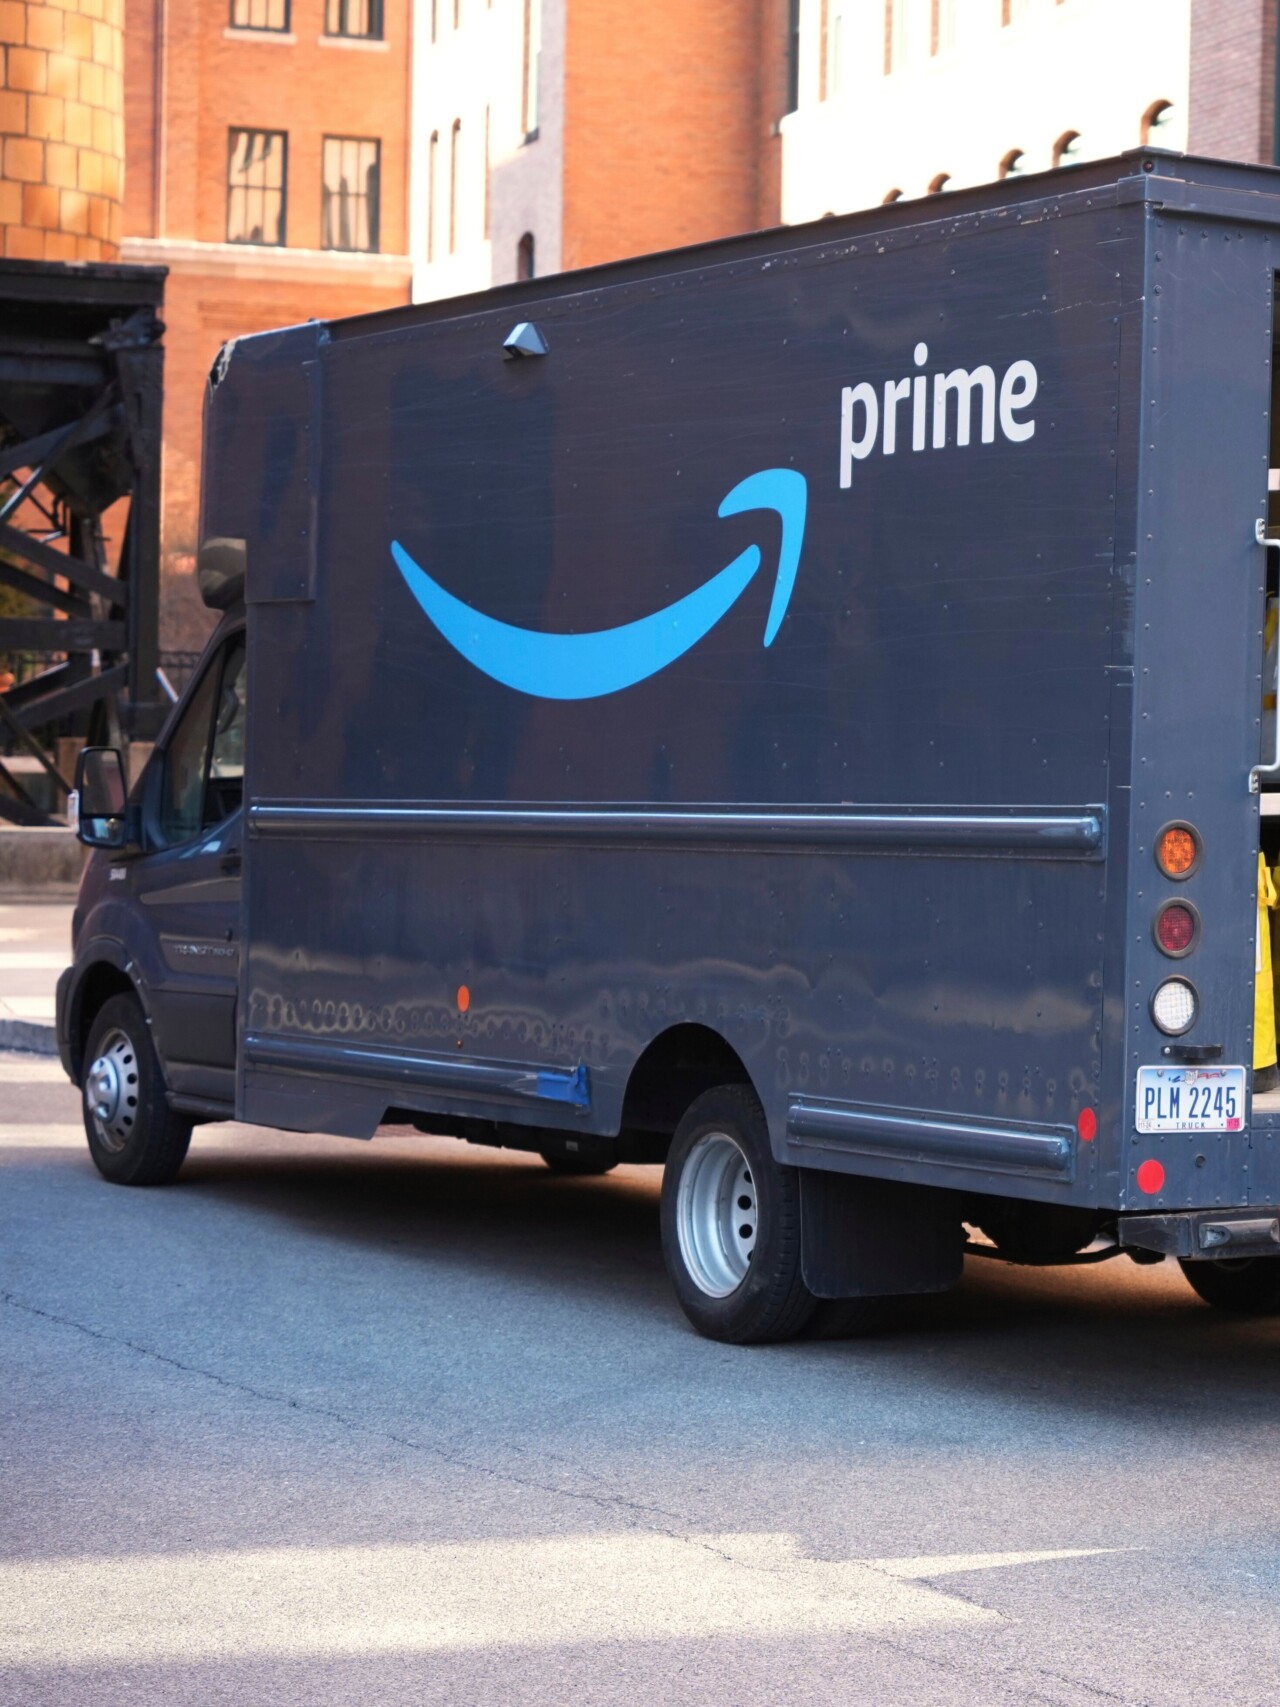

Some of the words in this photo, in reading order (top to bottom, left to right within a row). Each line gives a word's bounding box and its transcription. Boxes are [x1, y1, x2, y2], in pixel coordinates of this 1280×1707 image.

[839, 342, 1038, 489] prime
[1145, 1087, 1180, 1119] PLM
[1189, 1087, 1236, 1118] 2245
[1176, 1121, 1206, 1129] TRUCK
